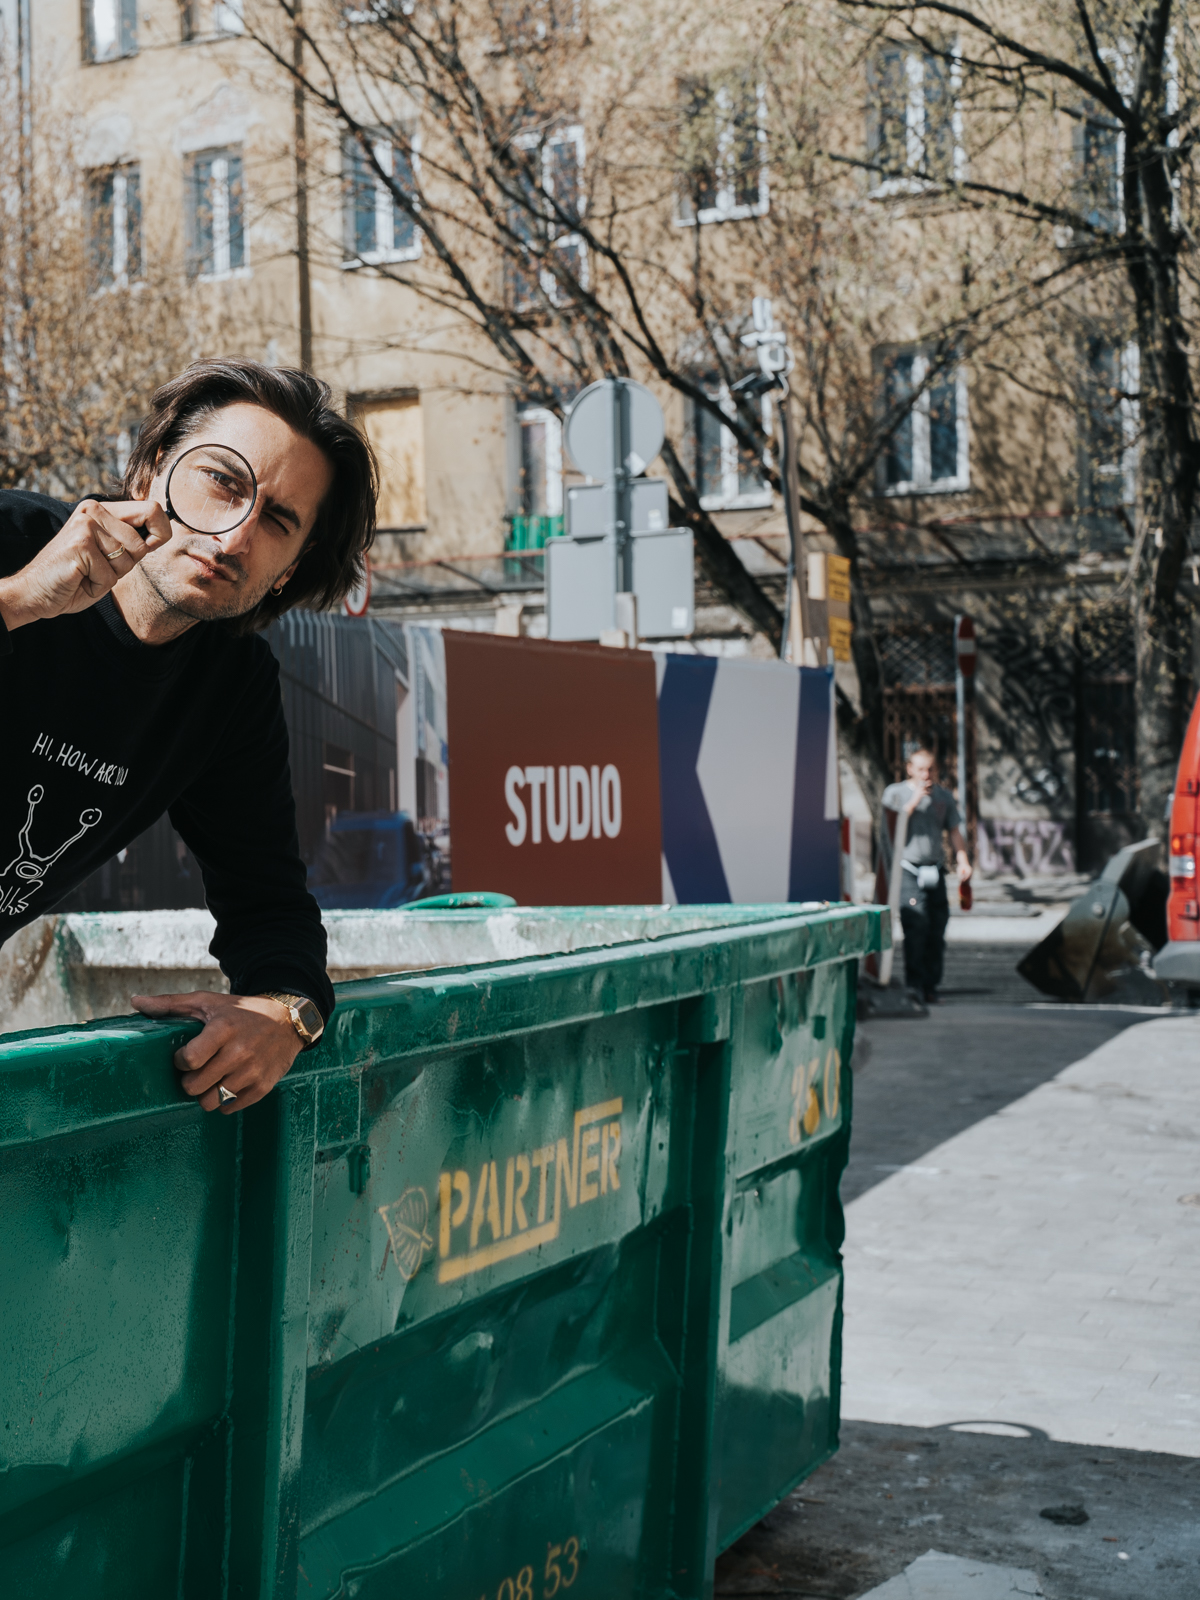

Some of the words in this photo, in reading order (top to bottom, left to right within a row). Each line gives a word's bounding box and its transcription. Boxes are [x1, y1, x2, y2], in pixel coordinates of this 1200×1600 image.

[31, 732, 54, 762] HI,
[56, 742, 99, 776] HOW
[93, 762, 118, 785] ARE
[504, 763, 622, 848] STUDIO
[438, 1108, 623, 1261] PARTNER
[544, 1536, 579, 1600] 53
